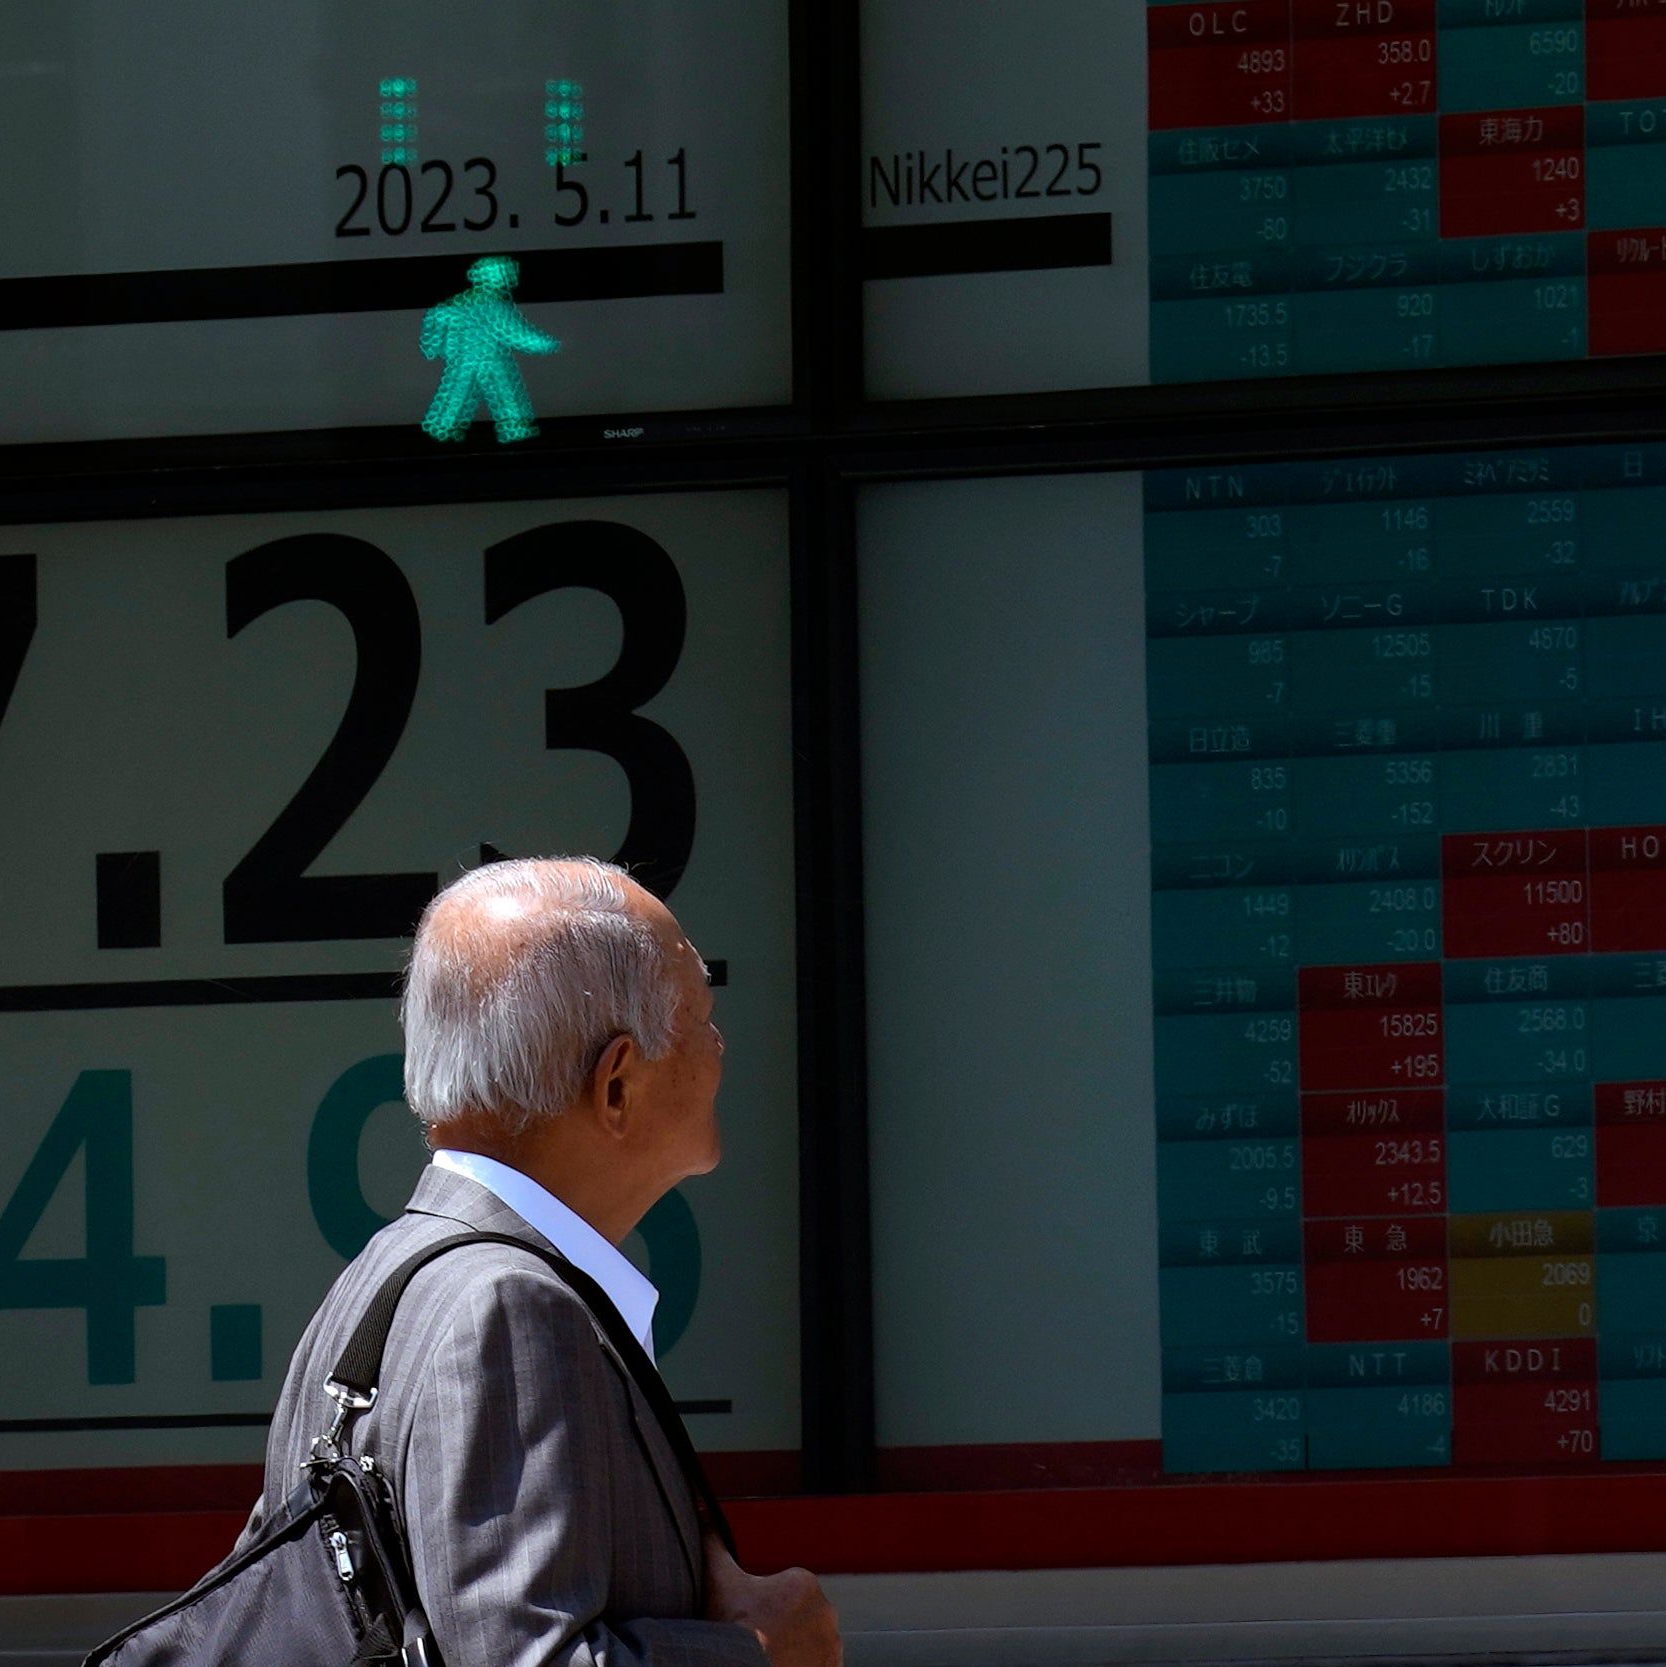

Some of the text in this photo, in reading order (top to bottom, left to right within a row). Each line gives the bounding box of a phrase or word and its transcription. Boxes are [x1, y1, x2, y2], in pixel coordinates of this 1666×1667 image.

[1237, 49, 1285, 75] 4893
[1377, 39, 1431, 66] 358.0
[1250, 90, 1285, 114] +33
[1389, 81, 1431, 106] +2.7
[1479, 115, 1544, 144] 東海力
[869, 142, 1103, 208] Nikkei225
[1531, 157, 1579, 182] 1240
[335, 147, 697, 238] 2023. 5.11
[1554, 198, 1579, 221] +3
[603, 427, 645, 440] SHARP
[1481, 588, 1537, 611] TDK
[1473, 839, 1557, 867] スクリン
[1524, 880, 1582, 905] 11500
[1546, 922, 1583, 945] +80
[1379, 1014, 1438, 1038] 15825
[1390, 1054, 1438, 1079] +195
[1388, 1183, 1441, 1207] +12.5
[1490, 1221, 1555, 1248] 小田急
[1397, 1268, 1443, 1291] 1962
[1420, 1308, 1443, 1330] +7
[1578, 1304, 1591, 1327] 0
[1349, 1352, 1406, 1377] NTT
[1544, 1390, 1590, 1414] 4291
[1557, 1431, 1592, 1454] +70
